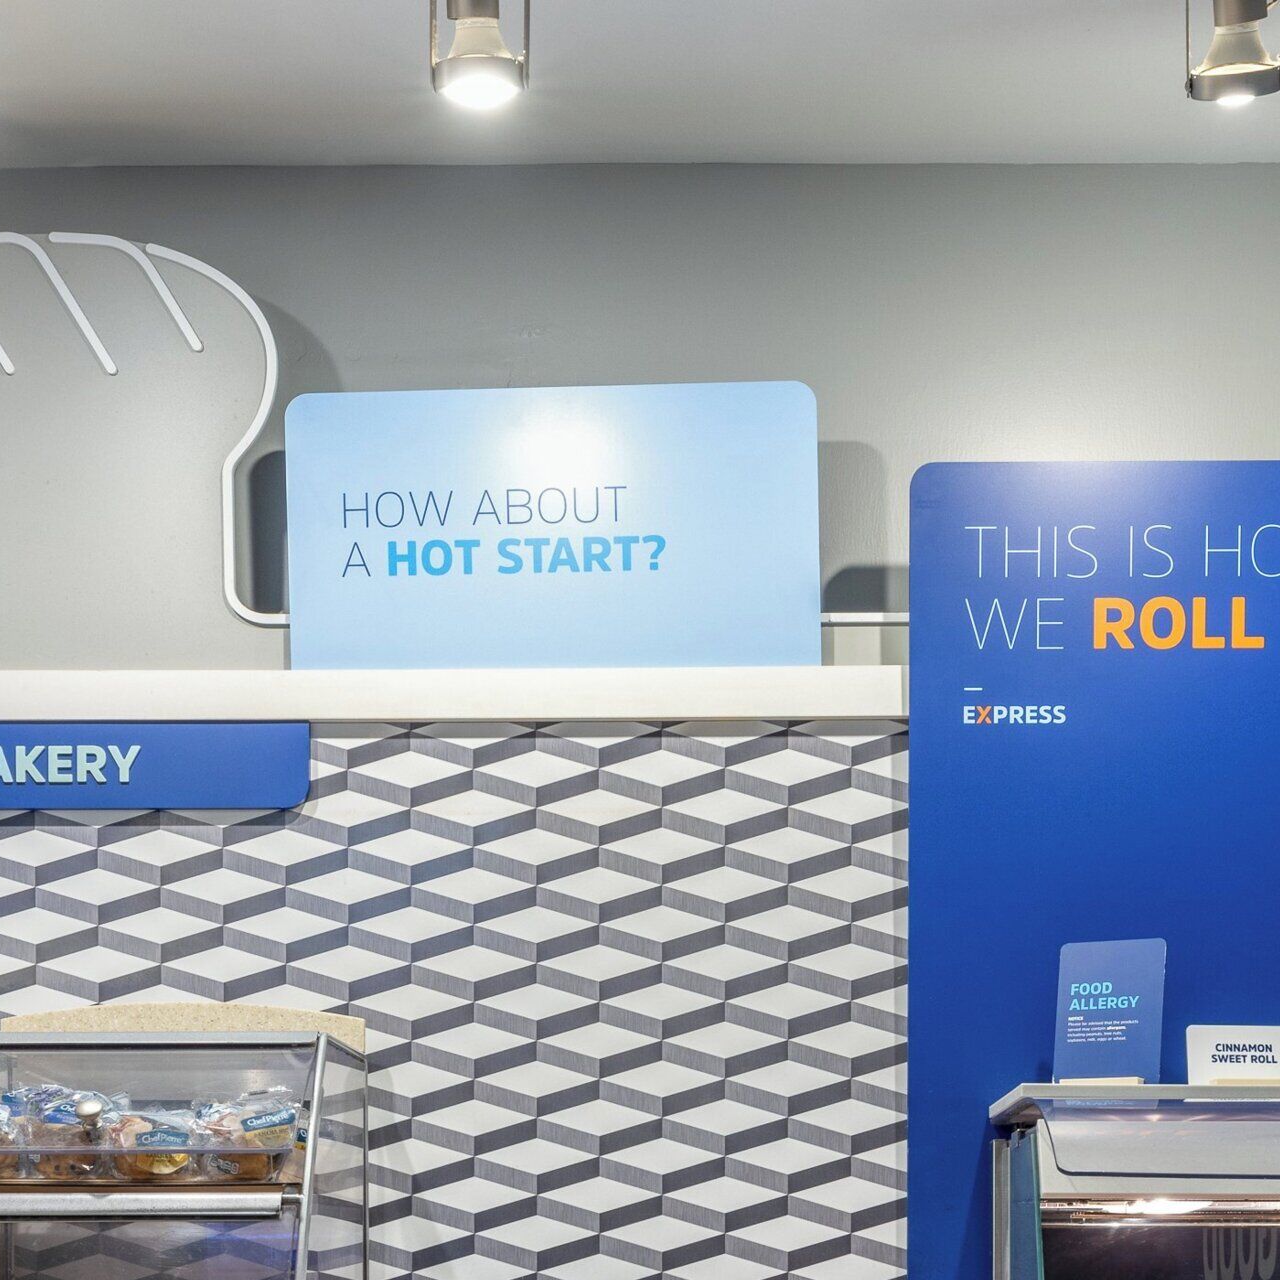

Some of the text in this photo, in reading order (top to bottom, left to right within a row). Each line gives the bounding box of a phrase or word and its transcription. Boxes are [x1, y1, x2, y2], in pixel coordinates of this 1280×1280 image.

[341, 485, 628, 529] HOW ABOUT
[341, 534, 667, 578] A HOT START?
[964, 525, 1099, 579] THIS
[1128, 524, 1175, 578] IS
[964, 596, 1265, 651] WE ROLL
[963, 705, 1067, 725] EXPRESS
[1070, 981, 1113, 996] FOOD
[1069, 995, 1140, 1011] ALLERGY
[1215, 1043, 1273, 1053] CINNAMON
[1211, 1054, 1278, 1064] SWEET ROLL
[141, 1132, 161, 1144] Chef
